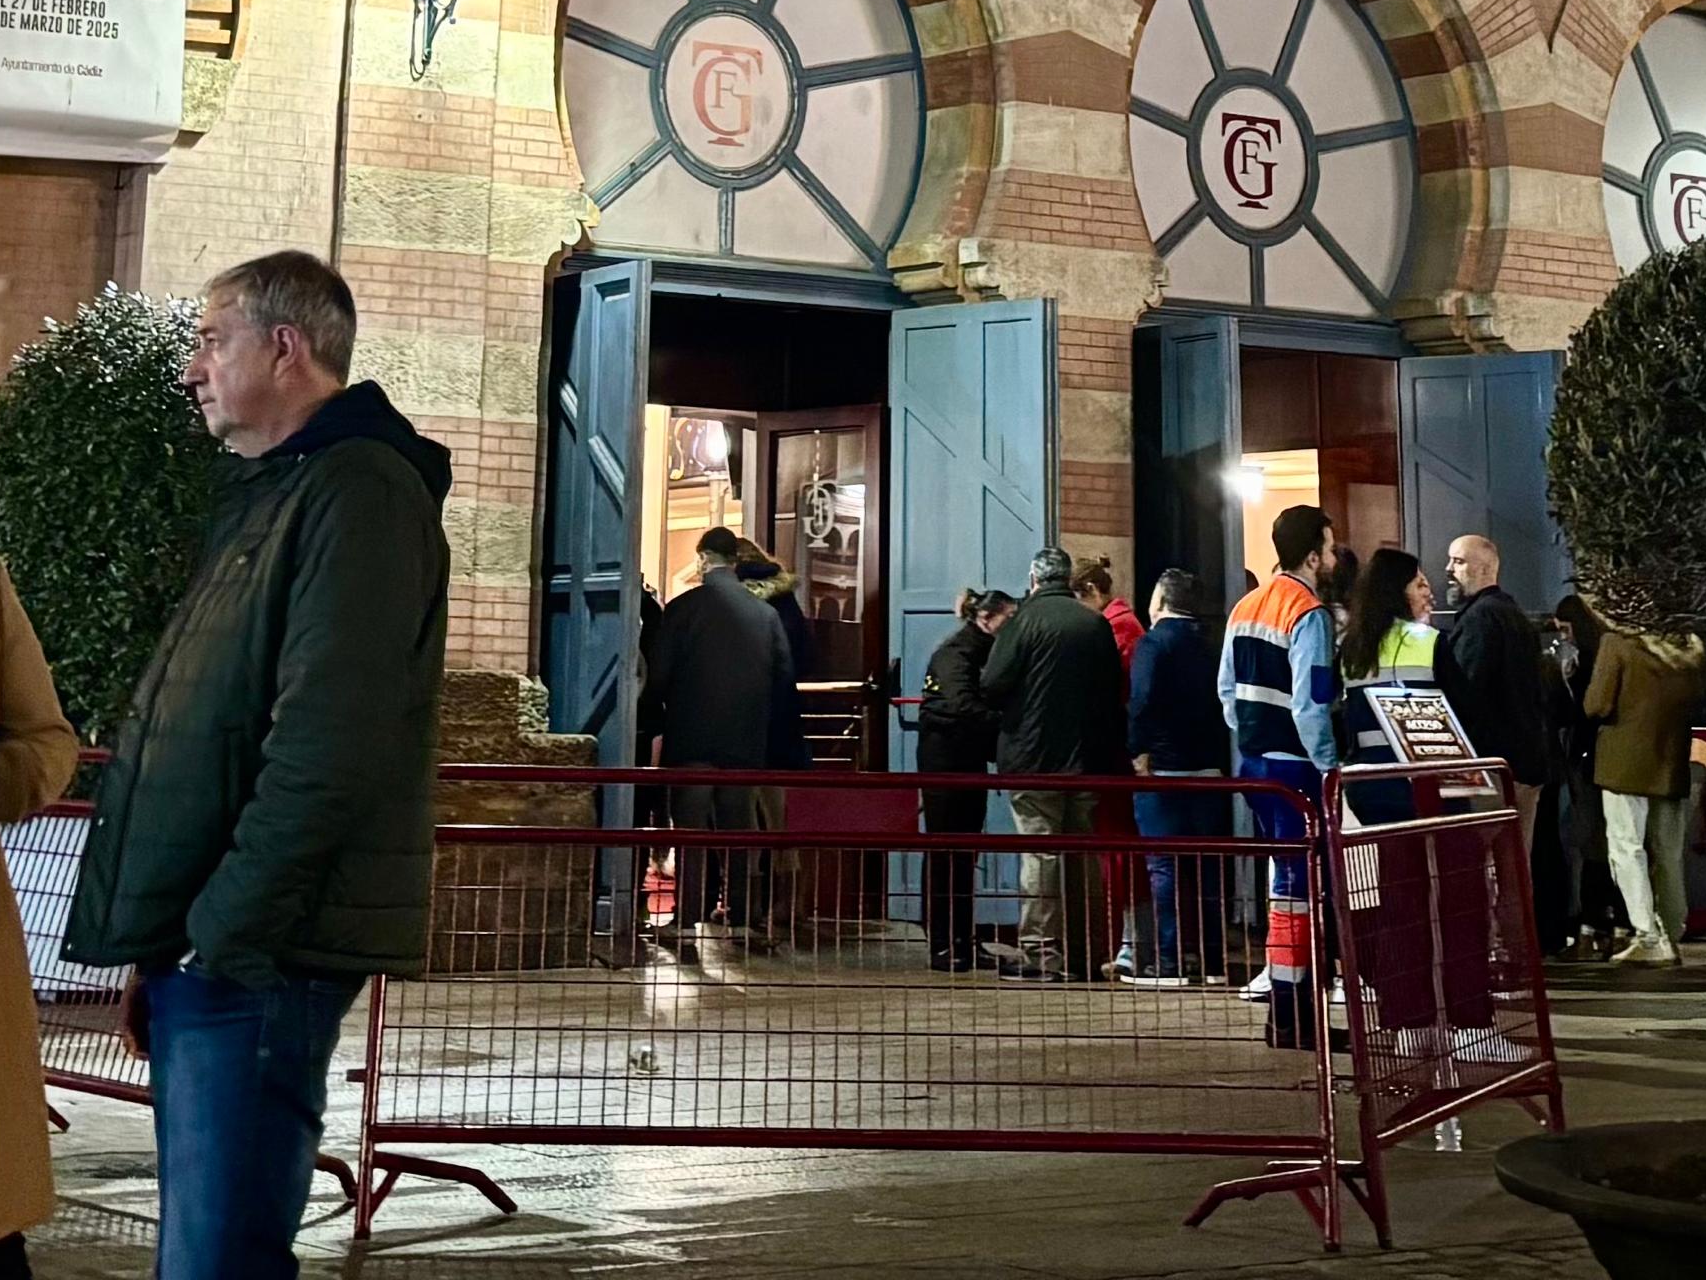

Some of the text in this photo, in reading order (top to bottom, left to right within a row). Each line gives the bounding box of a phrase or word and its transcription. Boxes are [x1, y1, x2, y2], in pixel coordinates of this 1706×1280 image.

[0, 11, 15, 29] DE
[20, 13, 63, 34] MARZO
[67, 19, 82, 36] DE
[86, 20, 119, 39] 2025
[1, 57, 103, 77] Ayuntamiento de Cádiz
